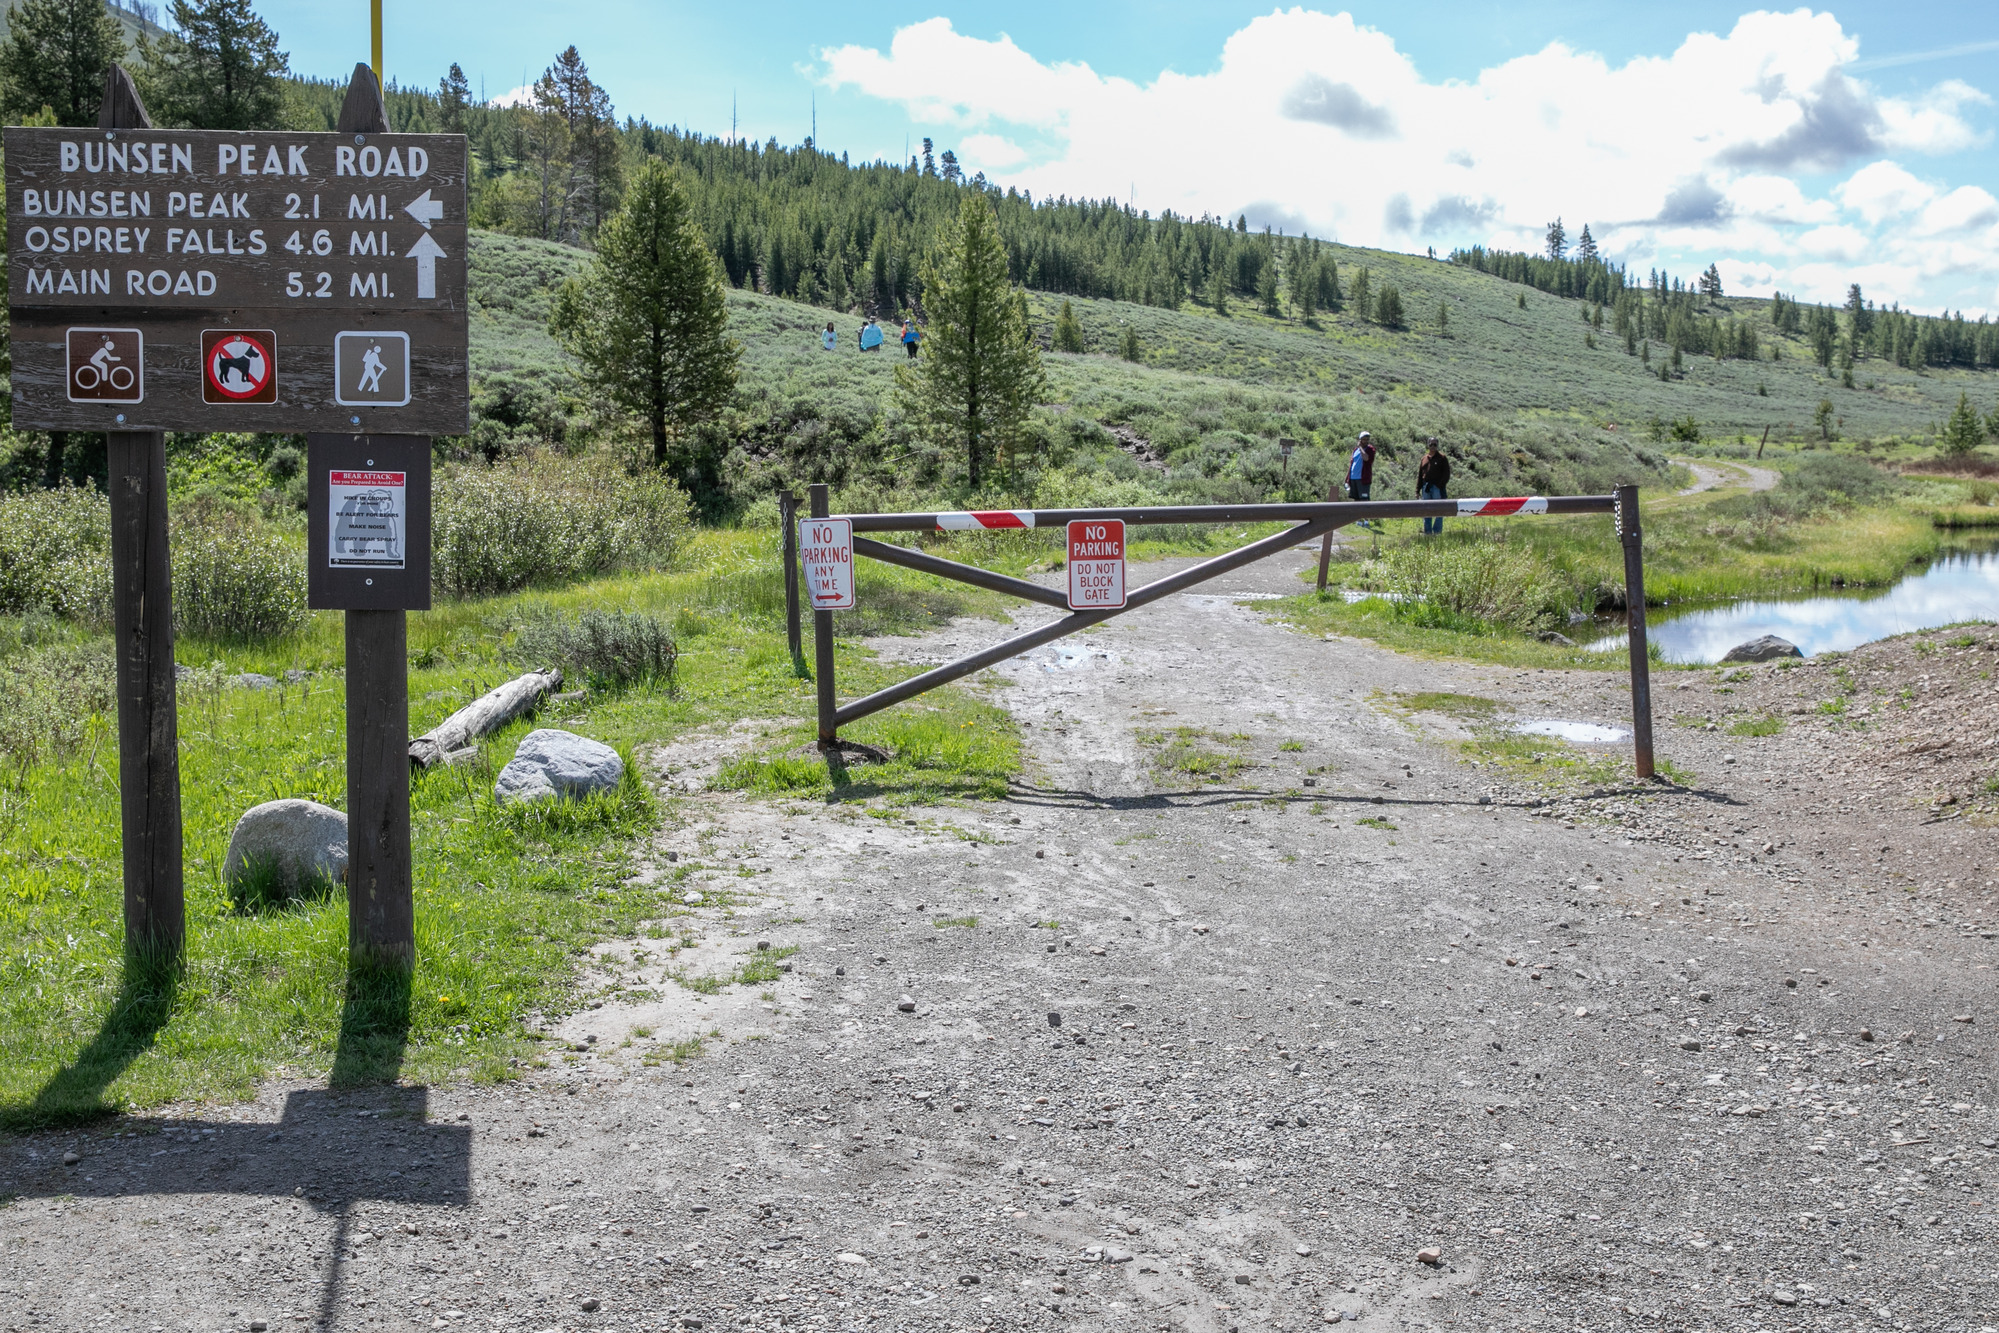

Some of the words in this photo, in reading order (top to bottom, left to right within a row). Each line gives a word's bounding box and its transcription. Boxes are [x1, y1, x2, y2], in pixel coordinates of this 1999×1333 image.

[60, 141, 193, 174] BUNSEN
[218, 144, 309, 176] PEAK
[336, 145, 429, 177] ROAD
[24, 189, 151, 218] BUNSEN
[168, 192, 250, 218] PEAK
[284, 193, 321, 219] 2.1
[348, 194, 394, 220] MI.
[25, 226, 151, 253] OSPREY
[166, 228, 267, 255] FALLS
[284, 229, 333, 256] 4.6
[349, 230, 396, 257] MI.
[26, 268, 110, 294] MAIN
[127, 269, 217, 296] ROAD
[286, 271, 333, 297] 5.2
[349, 272, 395, 298] MI.
[813, 527, 832, 544] NO
[1086, 526, 1106, 540] NO
[804, 546, 848, 564] PARKING
[1074, 542, 1119, 556] PARKING
[815, 566, 834, 577] ANY
[1078, 564, 1091, 574] DO
[1096, 563, 1115, 574] NOT
[815, 579, 838, 591] TIME
[1081, 576, 1113, 587] BLOCK
[1085, 589, 1109, 600] GATE
